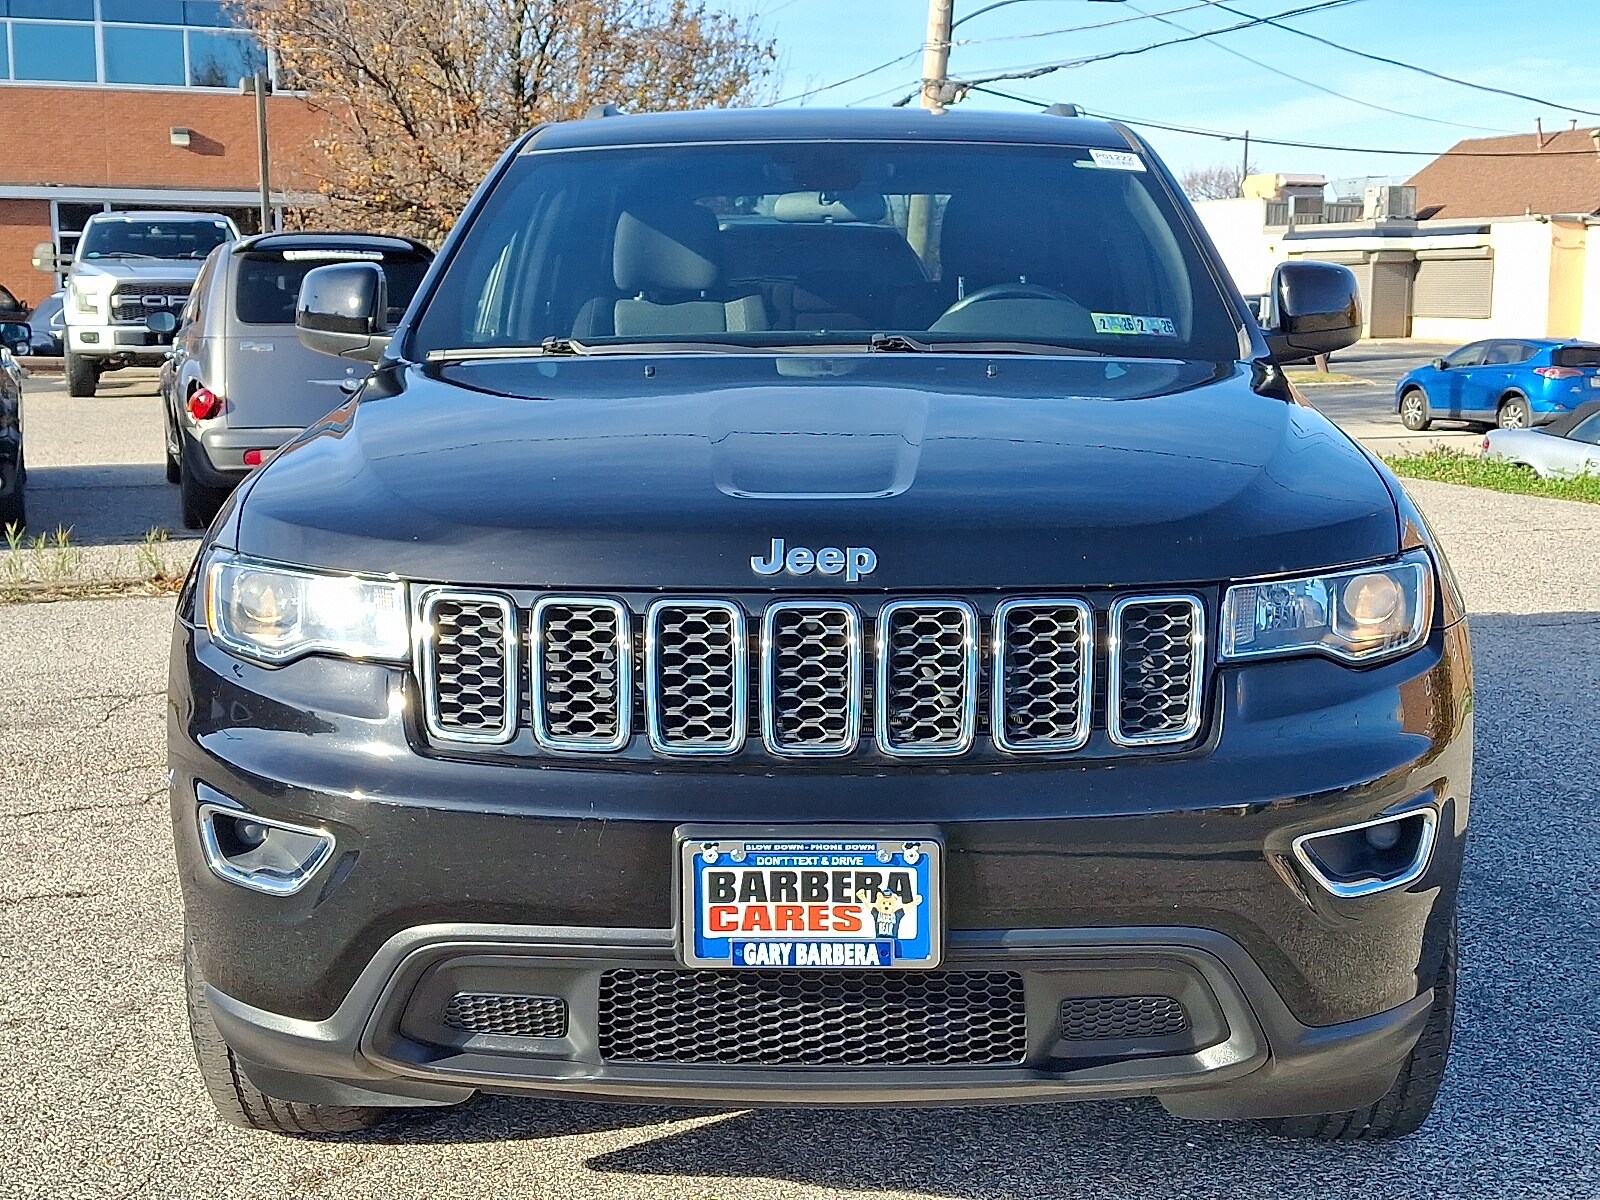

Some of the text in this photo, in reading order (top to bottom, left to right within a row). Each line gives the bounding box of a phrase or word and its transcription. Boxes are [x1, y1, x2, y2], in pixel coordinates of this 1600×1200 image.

[1100, 318, 1108, 330] 2
[1137, 319, 1146, 332] 2
[750, 537, 877, 582] Jeep
[745, 843, 771, 851] SLOW
[774, 843, 804, 851] DOWN
[810, 843, 842, 851] PHONE
[845, 843, 875, 851] DOWN
[756, 856, 864, 866] DON'T TEXT & DRIVE
[708, 870, 915, 903] BARBERA
[709, 905, 863, 931] CARES
[743, 943, 880, 966] GARY BARBERA
